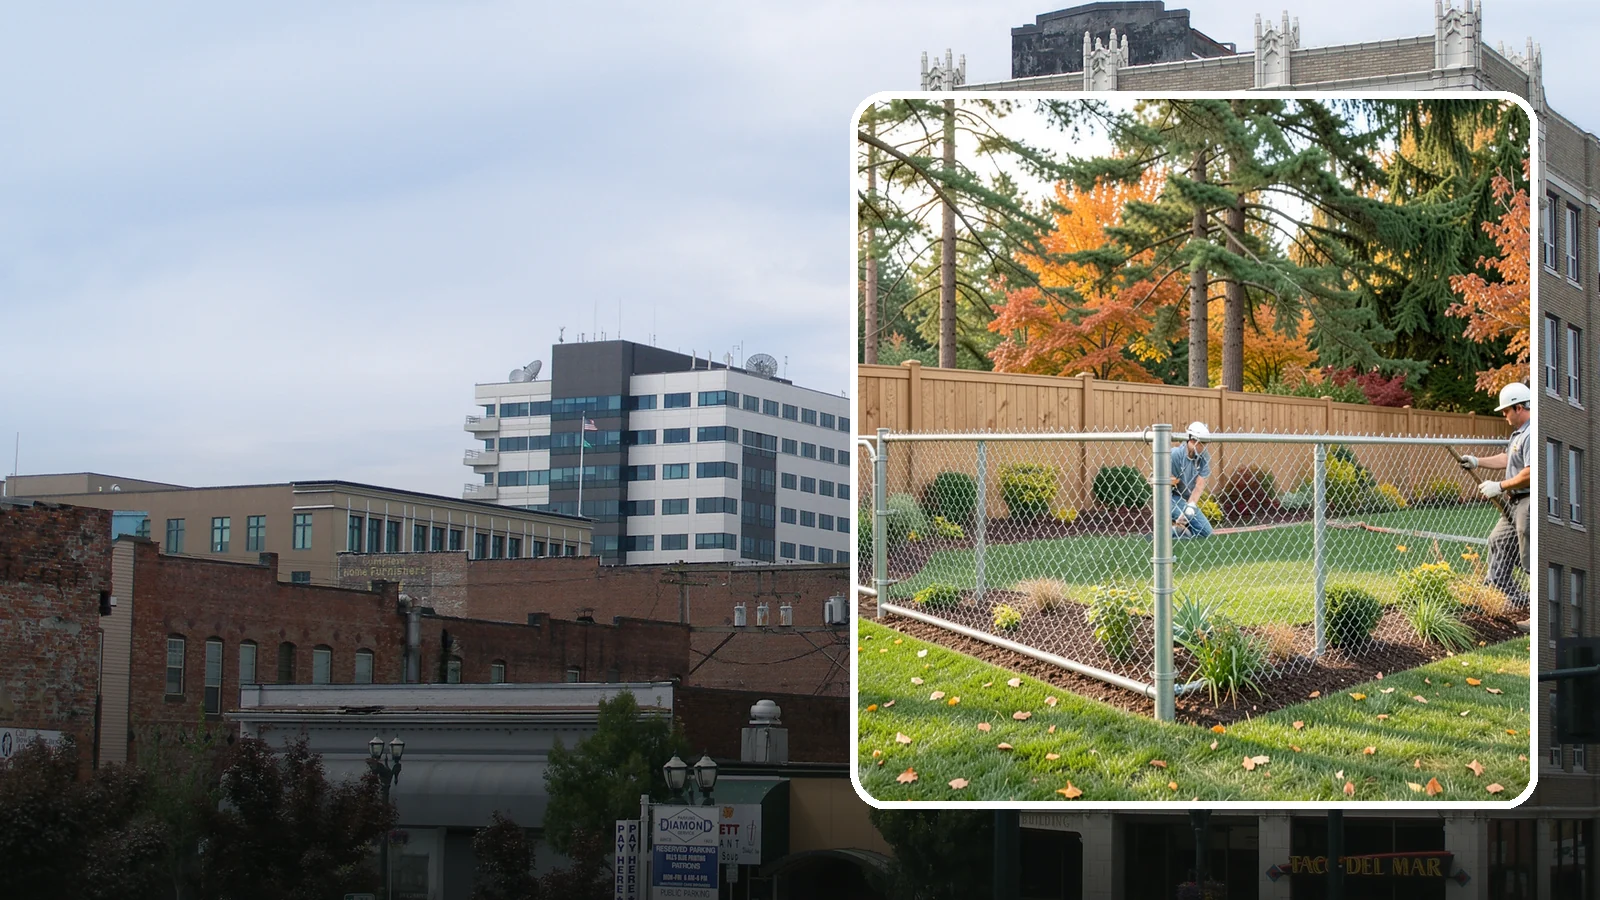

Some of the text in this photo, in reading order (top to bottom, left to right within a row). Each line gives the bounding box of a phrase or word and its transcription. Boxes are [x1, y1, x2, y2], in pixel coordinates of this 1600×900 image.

[343, 566, 426, 577] Home Furnishers
[660, 818, 713, 832] DIAMOND
[1022, 815, 1069, 827] BUILDING
[617, 825, 625, 852] PAY
[628, 824, 636, 852] PAY
[656, 845, 716, 854] RESERVED PARKING
[721, 851, 739, 862] Soup
[671, 862, 701, 870] PATRONS
[1289, 856, 1443, 877] TAC DEL MAR
[616, 856, 625, 894] HERE
[628, 856, 636, 893] HERE
[660, 888, 710, 898] PUBLIC PARKING
